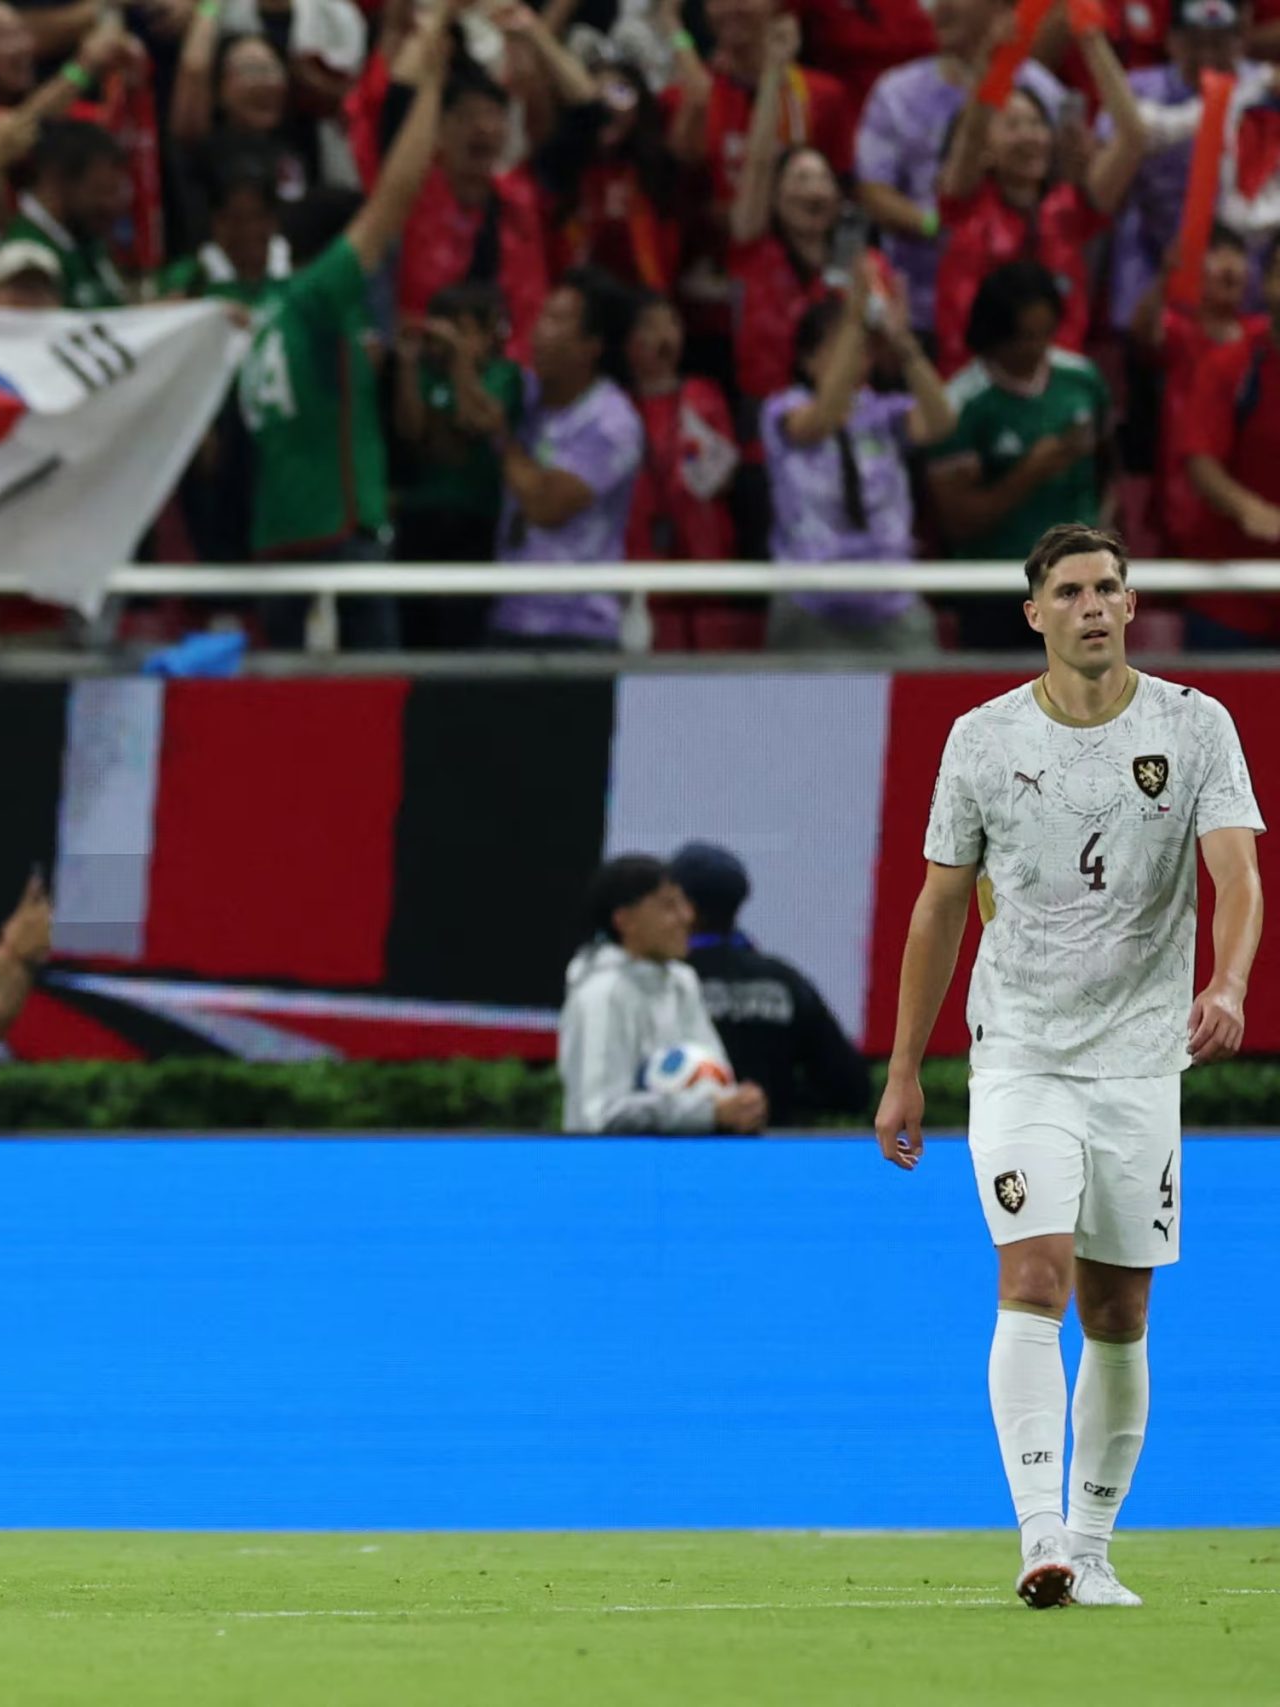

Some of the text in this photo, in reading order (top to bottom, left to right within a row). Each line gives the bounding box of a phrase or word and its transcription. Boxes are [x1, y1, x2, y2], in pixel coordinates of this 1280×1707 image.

[1079, 832, 1106, 890] 4
[1159, 1149, 1174, 1208] 4
[1021, 1451, 1054, 1466] CZE
[1083, 1481, 1118, 1498] CZE
